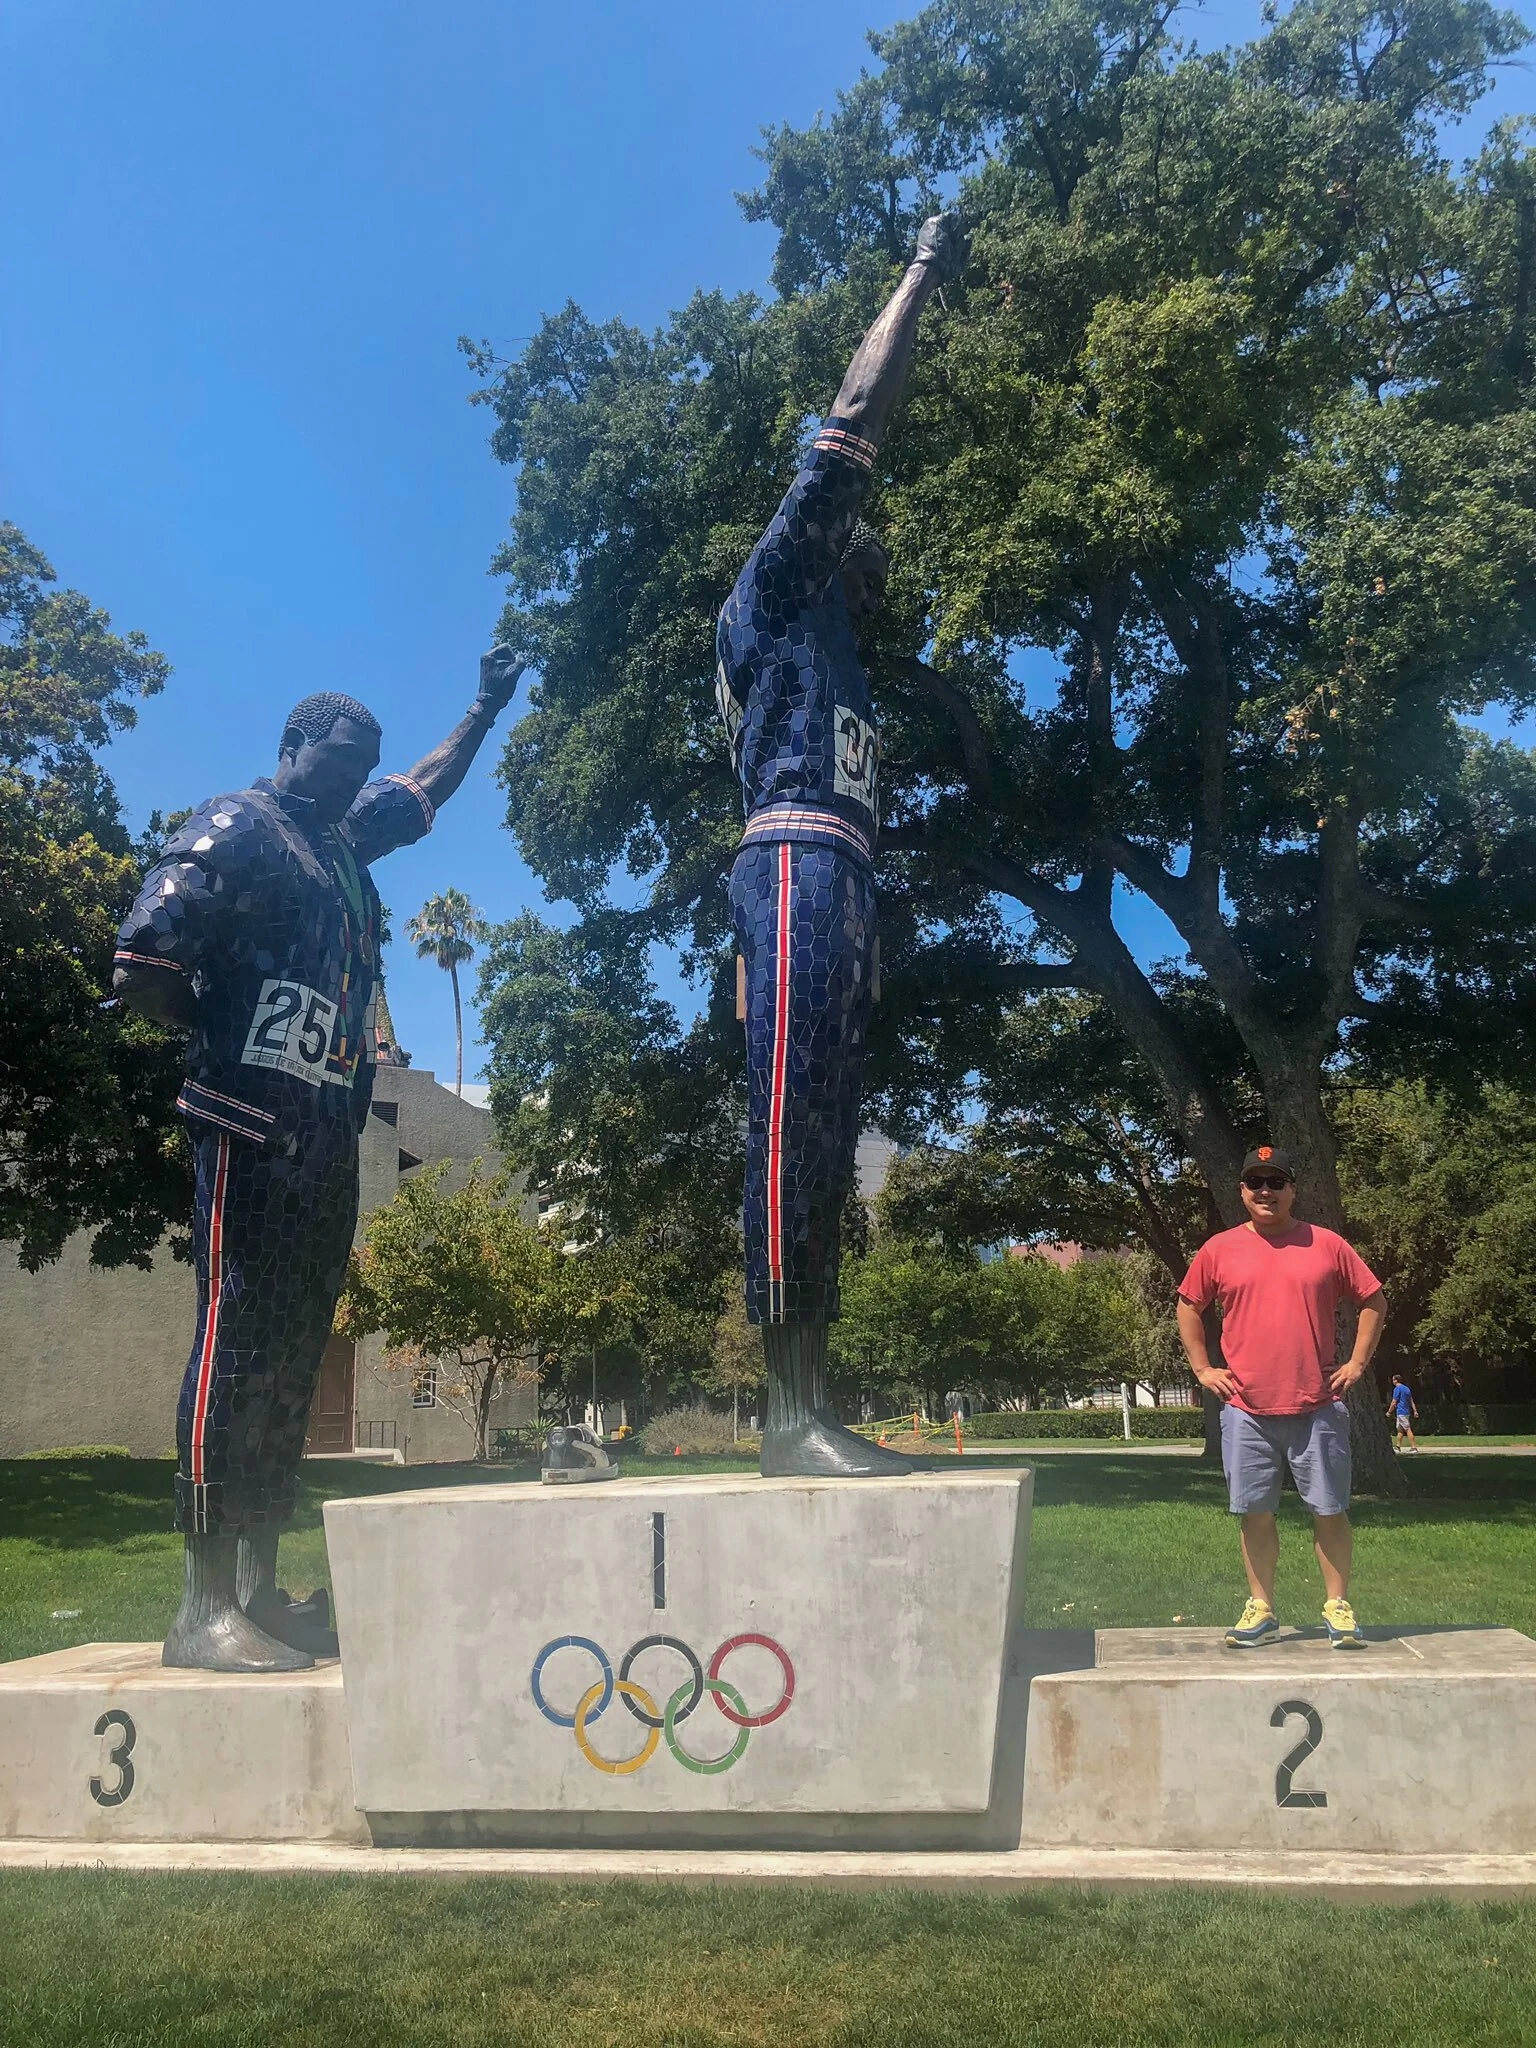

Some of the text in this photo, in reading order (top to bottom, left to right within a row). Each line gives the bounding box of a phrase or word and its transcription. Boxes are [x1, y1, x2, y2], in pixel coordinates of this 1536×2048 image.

[252, 986, 332, 1064] 25
[89, 1708, 137, 1808] 3
[1269, 1700, 1329, 1808] 2
